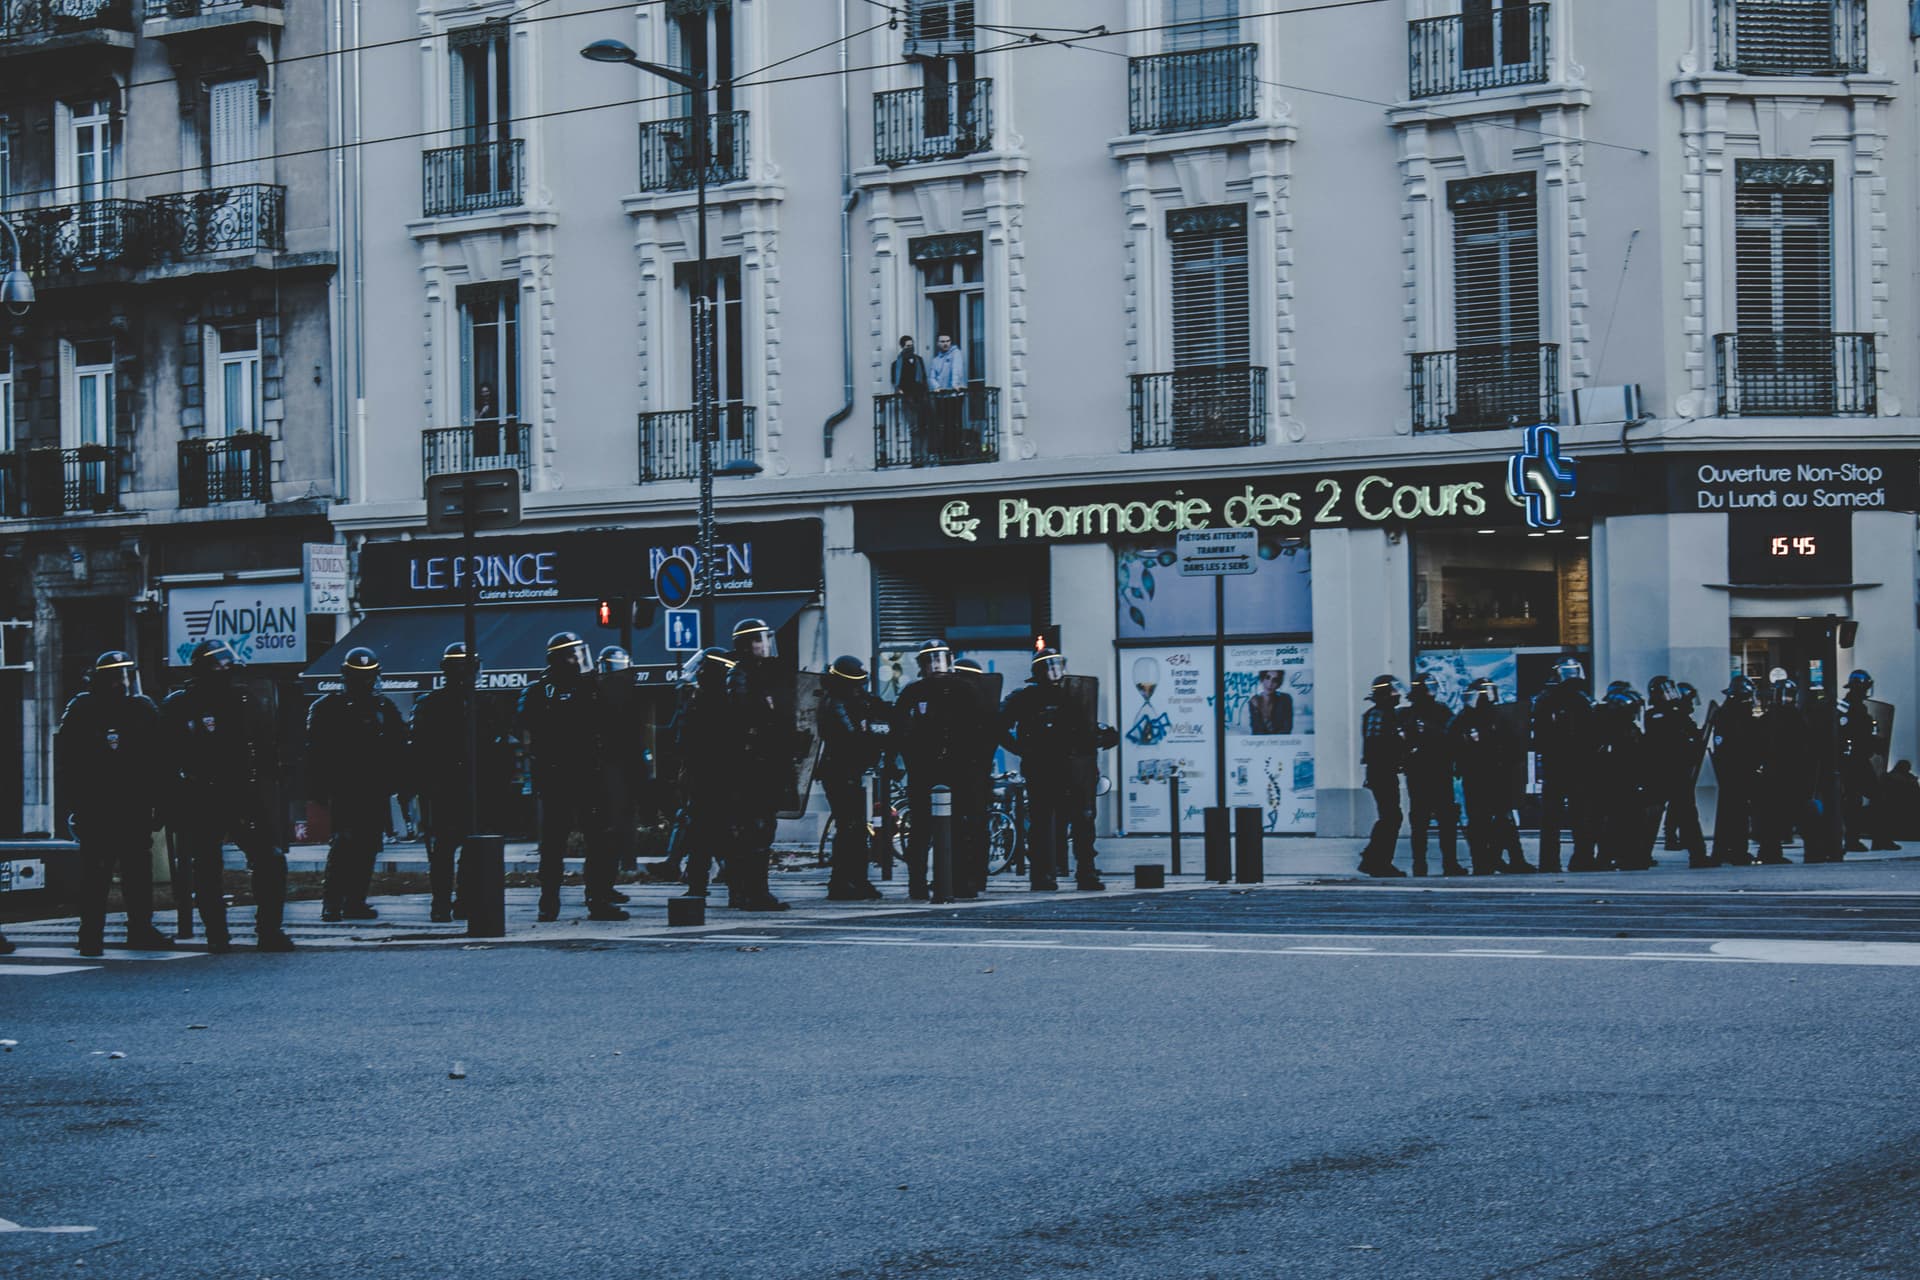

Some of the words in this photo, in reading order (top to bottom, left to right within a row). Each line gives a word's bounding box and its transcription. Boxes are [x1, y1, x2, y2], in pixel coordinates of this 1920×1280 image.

[1698, 464, 1792, 483] Ouverture
[1797, 463, 1883, 484] Non-Stop
[1697, 490, 1723, 508] Du
[1729, 490, 1778, 508] Lundi
[1783, 493, 1808, 507] au
[1813, 488, 1885, 507] Samedi
[998, 490, 1212, 539] Pharmacie
[1224, 485, 1302, 528] des
[1314, 479, 1342, 523] 2
[1355, 475, 1486, 521] Cours
[1213, 531, 1254, 540] ATTENTION
[1197, 546, 1236, 554] TRAMWAY
[1771, 537, 1788, 556] 15
[1793, 536, 1816, 556] 45
[410, 557, 447, 590] LE
[1184, 564, 1204, 572] DANS
[1206, 563, 1220, 571] LES
[1222, 562, 1227, 571] 2
[1229, 562, 1249, 570] SENS
[479, 590, 507, 599] Cuisine
[508, 587, 559, 598] traditionnelle
[215, 601, 296, 635] INDIAN
[255, 633, 296, 649] store
[1276, 646, 1298, 656] poids
[1282, 657, 1304, 665] santé
